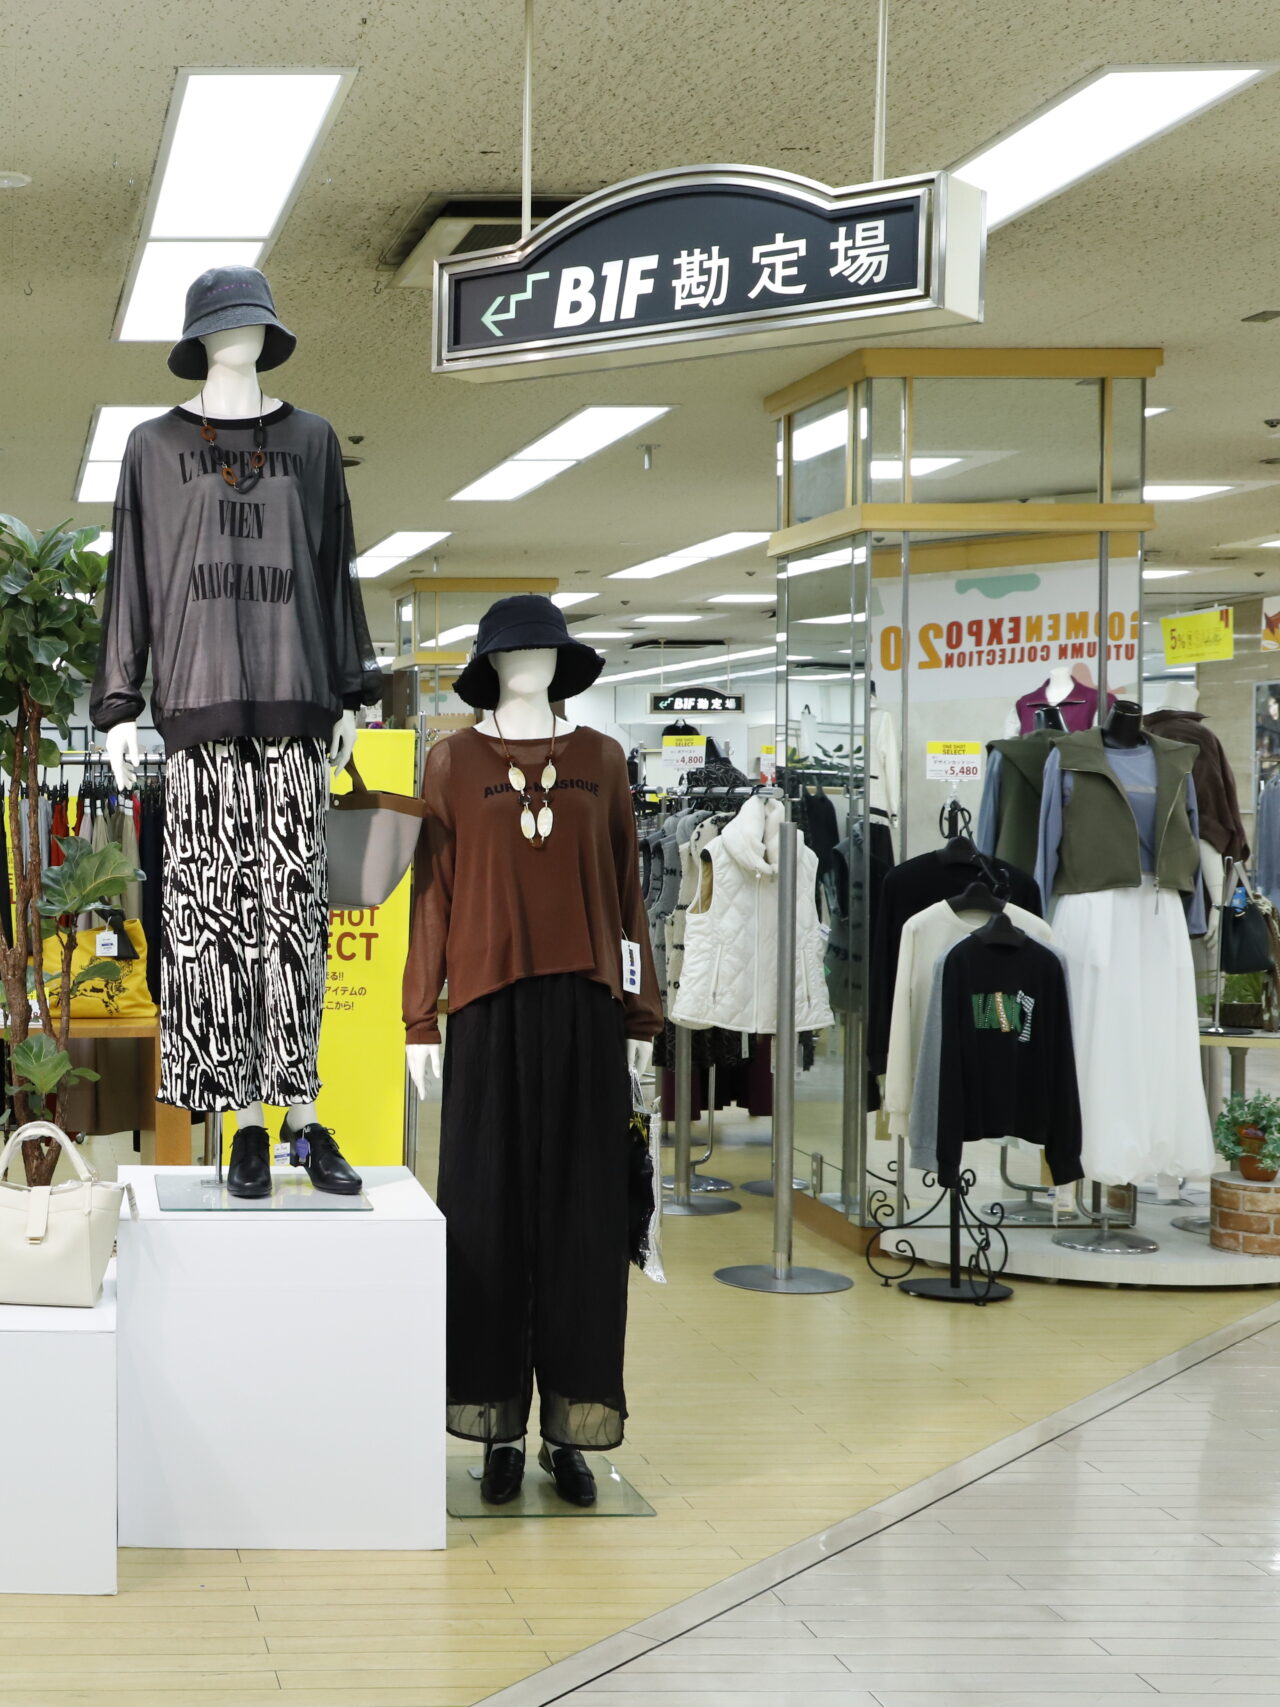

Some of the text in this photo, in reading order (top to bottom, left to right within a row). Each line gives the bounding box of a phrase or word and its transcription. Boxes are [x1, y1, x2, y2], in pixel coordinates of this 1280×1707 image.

[553, 219, 891, 329] B1F 勘定場
[218, 499, 266, 539] VIEN
[323, 1001, 354, 1010] こから!
